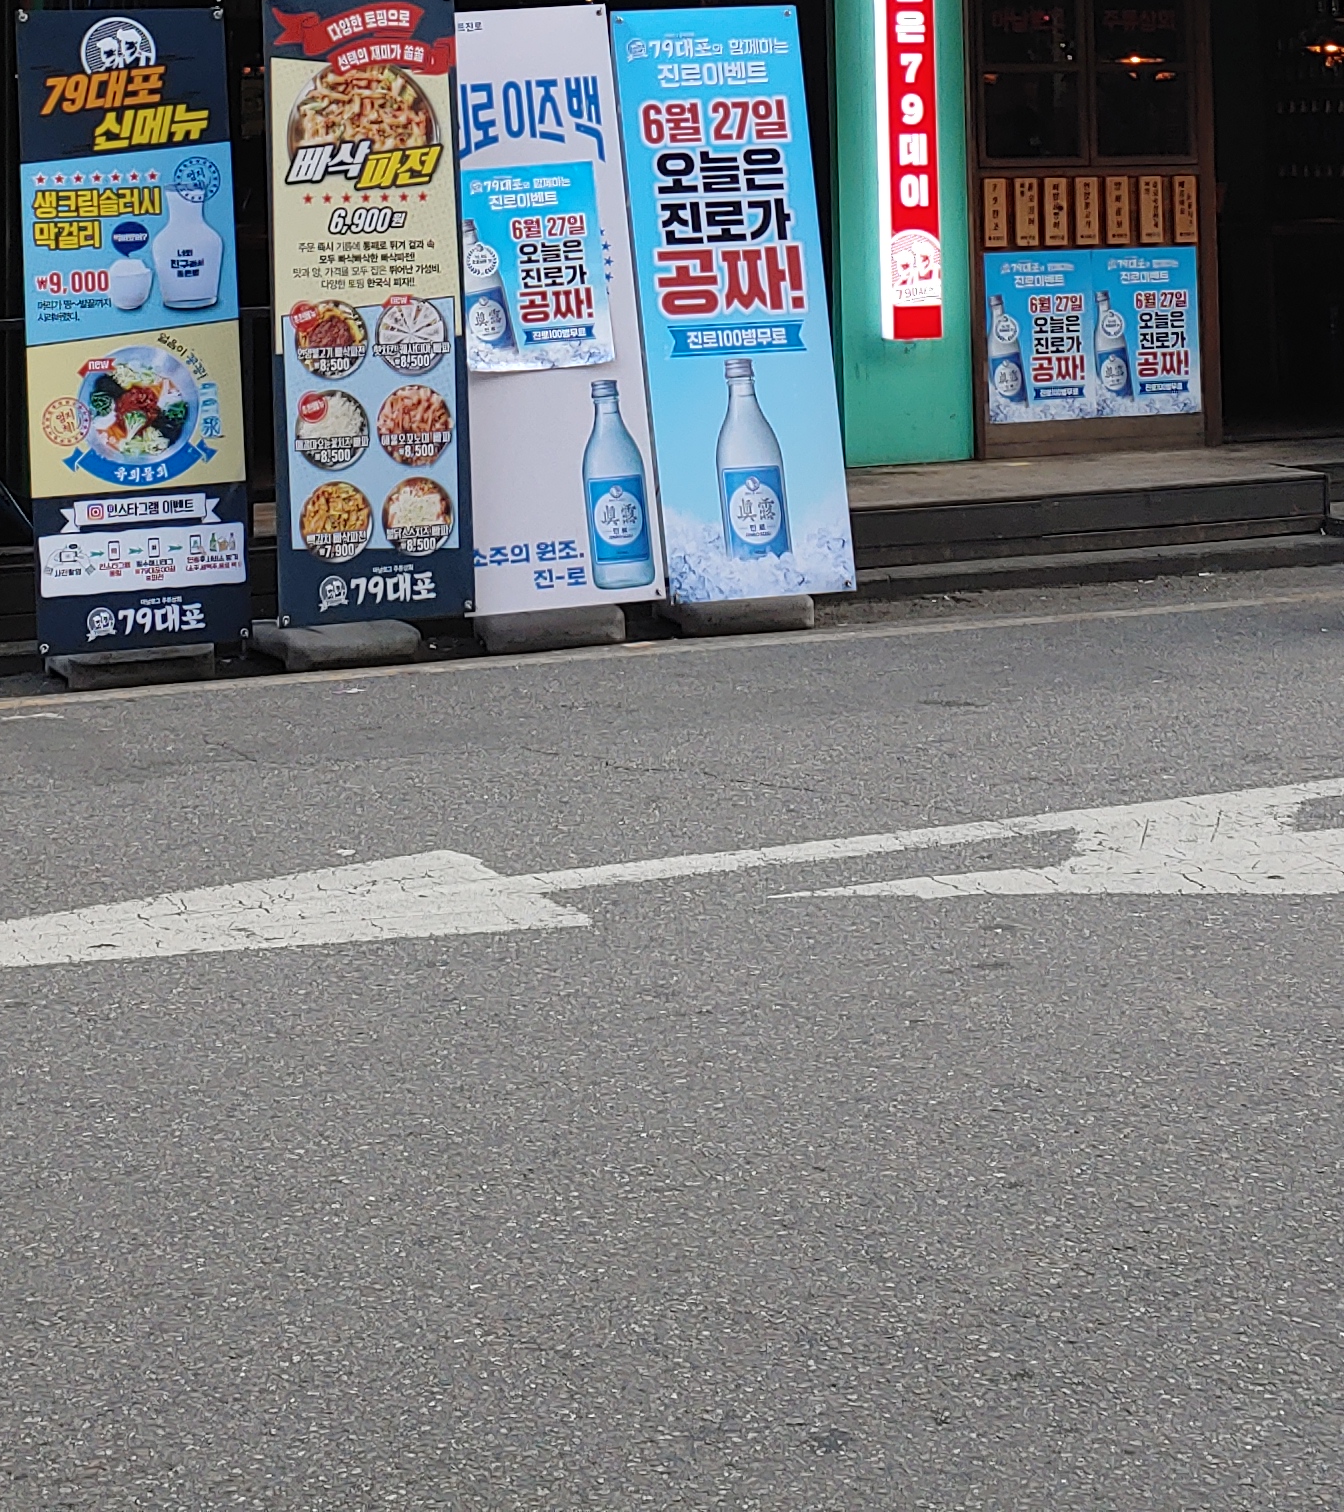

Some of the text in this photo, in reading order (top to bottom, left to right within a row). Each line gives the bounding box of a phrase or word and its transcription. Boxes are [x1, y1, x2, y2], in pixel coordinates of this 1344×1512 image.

[326, 9, 411, 42] 다양한 토핑으로
[656, 61, 769, 88] 진로이벤트
[40, 65, 167, 116] 79대포
[93, 102, 209, 152] 신메뉴
[641, 97, 790, 145] 6월 27일
[655, 146, 786, 195] 오늘은
[33, 187, 162, 219] 생크림슬러시
[489, 191, 558, 210] 진로이벤트
[33, 220, 102, 251] 막걸리
[510, 213, 586, 241] 6월 27일
[659, 197, 791, 246] 진로가
[518, 239, 584, 264] 오늘은
[520, 263, 588, 289] 진로가
[657, 243, 805, 315] 공짜!
[519, 286, 595, 323] 공짜!
[1029, 293, 1085, 314] 6월 27일
[1134, 290, 1188, 310] 6월 27일
[1033, 315, 1080, 334] 오늘은
[1138, 310, 1185, 331] 오늘은
[1034, 335, 1082, 354] 진로가
[1139, 331, 1186, 349] 진로가
[88, 360, 109, 370] new
[1032, 355, 1086, 383] 공짜!
[1137, 350, 1189, 378] 공짜!
[107, 499, 194, 518] 인스타그램 이벤트
[350, 572, 436, 605] 79대포
[118, 603, 206, 635] 79대포
